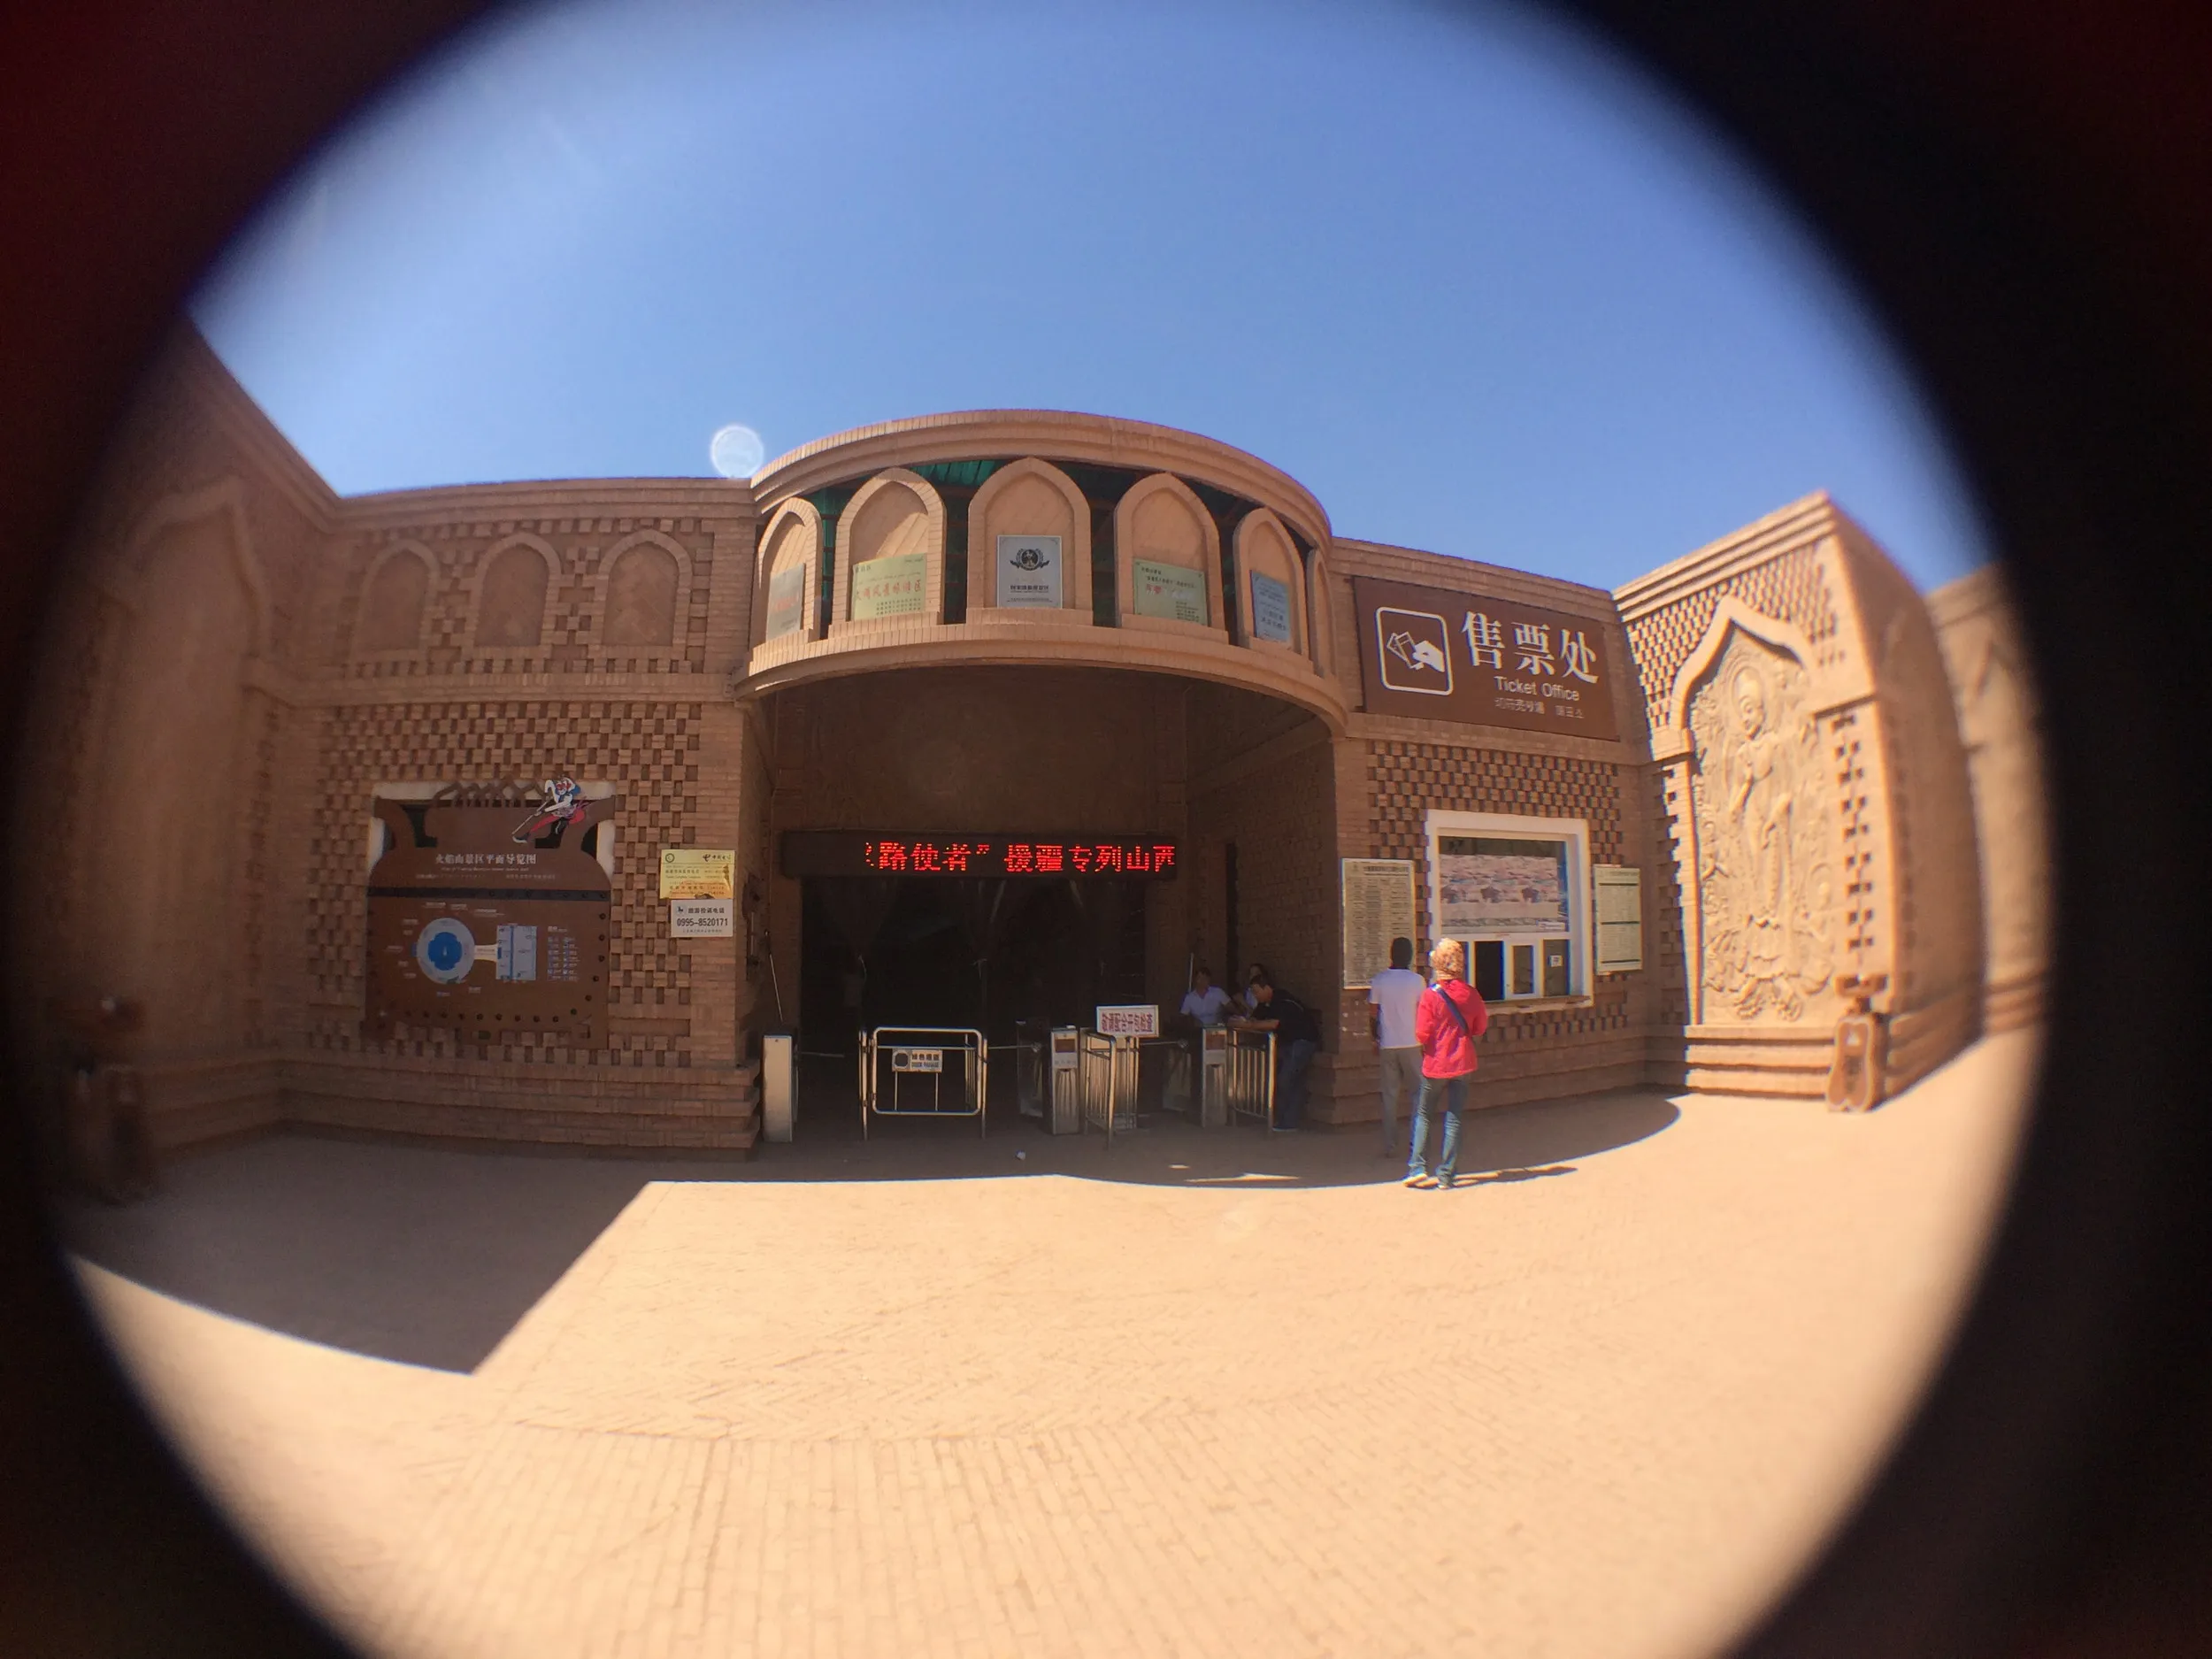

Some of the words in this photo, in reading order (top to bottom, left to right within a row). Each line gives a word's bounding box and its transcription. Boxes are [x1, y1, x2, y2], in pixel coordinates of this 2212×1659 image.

[1462, 611, 1599, 684] 售票处
[1494, 675, 1538, 695] Ticket
[1541, 682, 1580, 702] Office
[435, 853, 537, 865] 火焰山景区平面导览图
[676, 918, 728, 927] 0995-8520171
